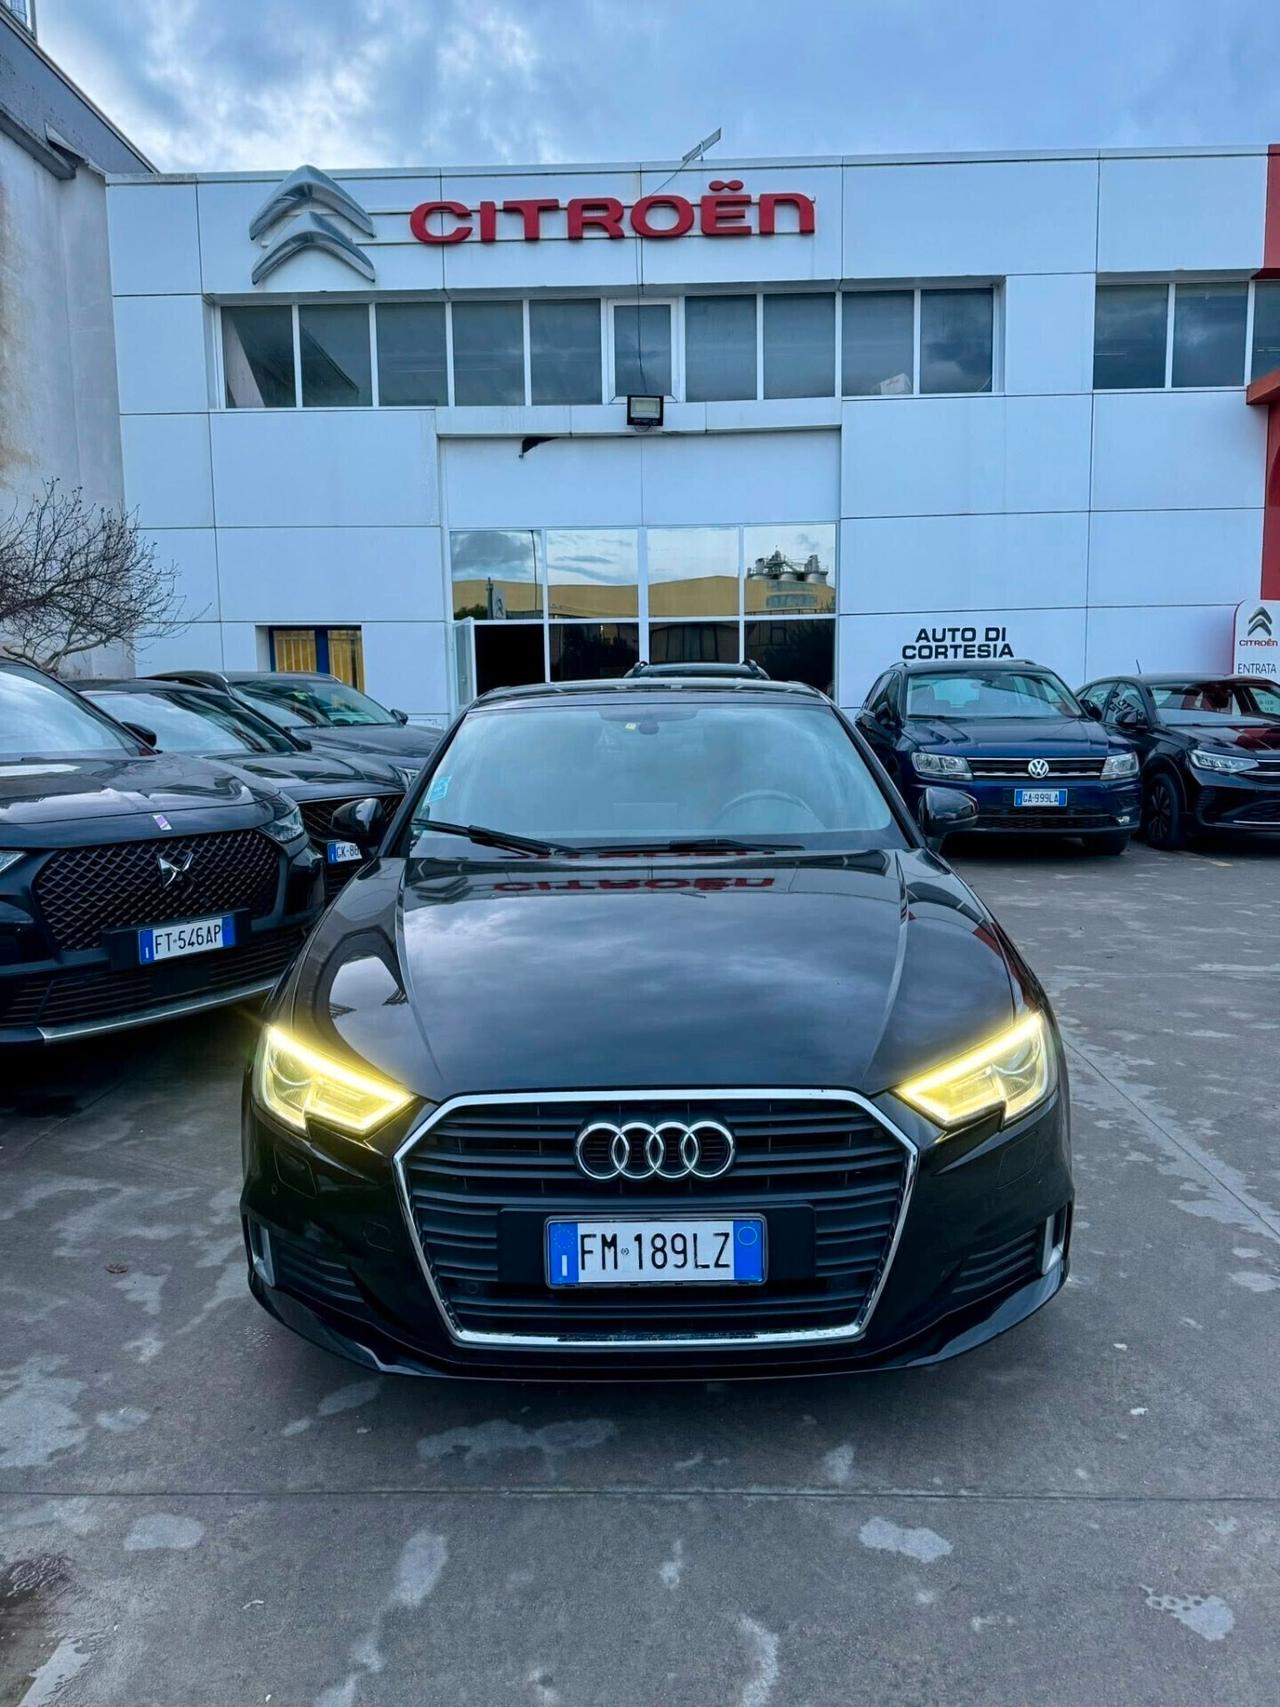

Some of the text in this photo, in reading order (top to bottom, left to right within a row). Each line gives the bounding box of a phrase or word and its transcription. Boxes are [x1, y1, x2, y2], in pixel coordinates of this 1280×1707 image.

[915, 627, 1006, 643] AUTO DI
[902, 643, 1015, 660] CORTESIA
[1237, 663, 1277, 675] ENTRATA
